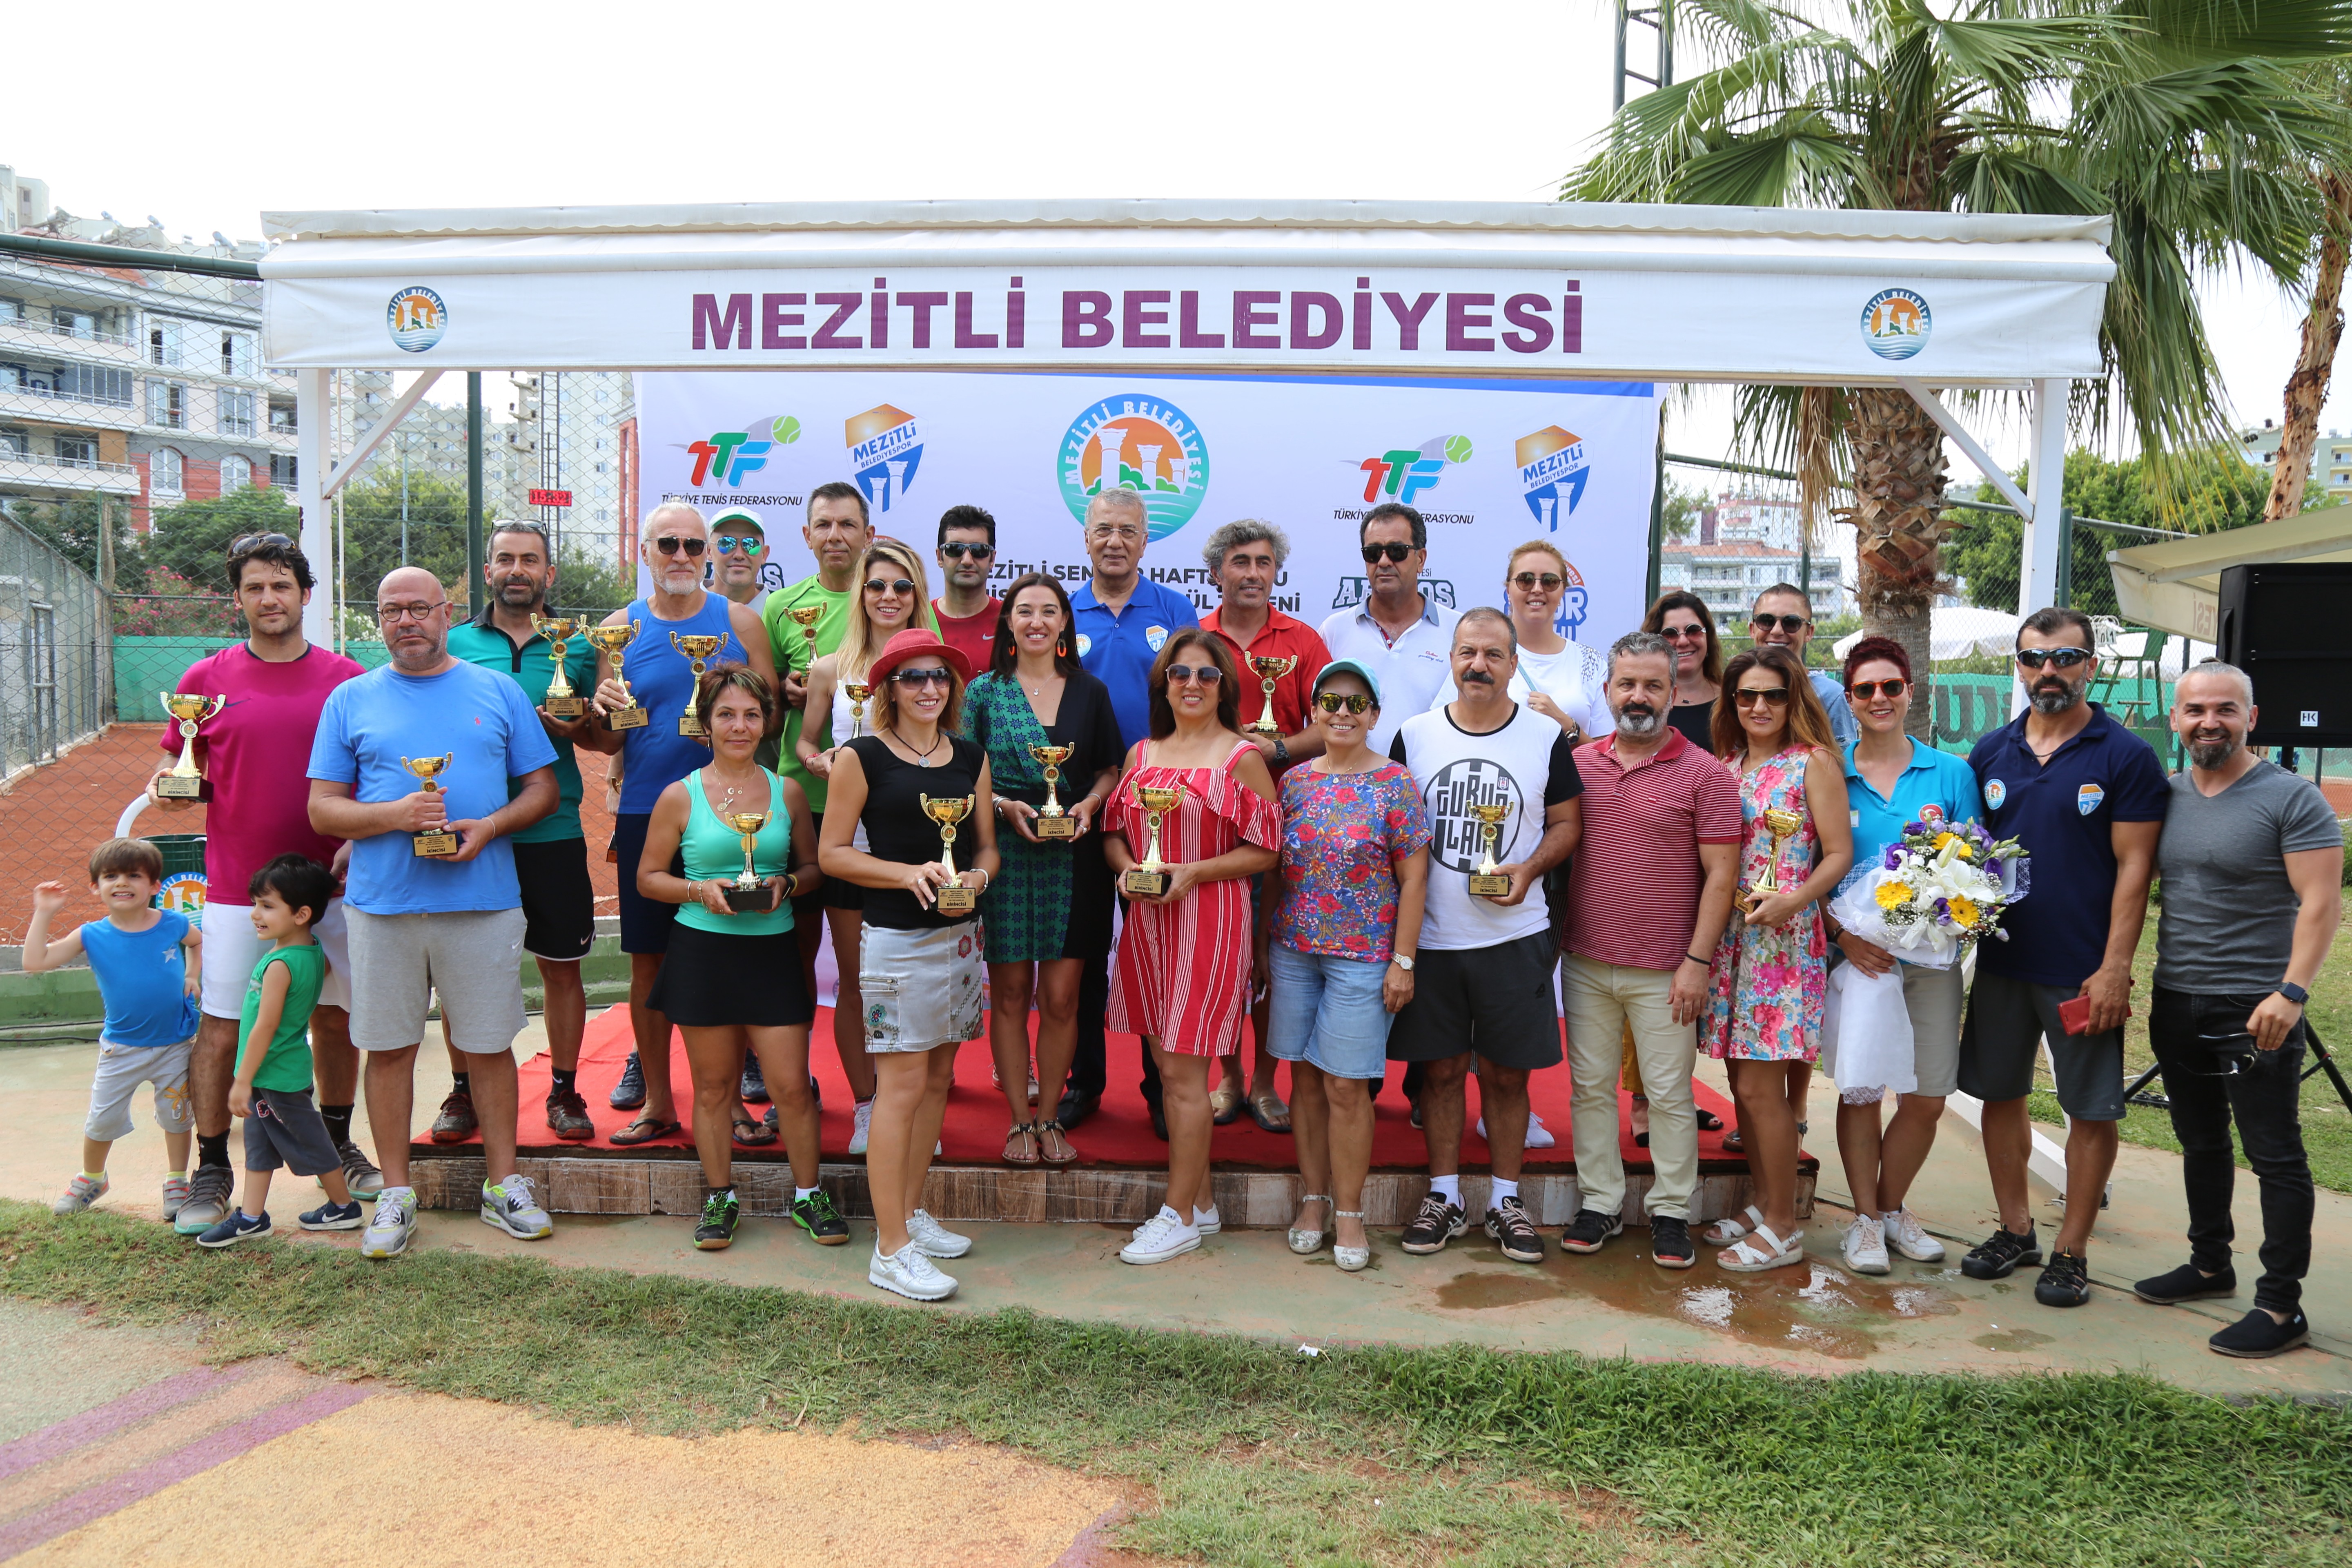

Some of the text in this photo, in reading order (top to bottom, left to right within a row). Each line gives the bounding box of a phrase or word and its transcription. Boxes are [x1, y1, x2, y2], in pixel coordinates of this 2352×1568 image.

[390, 289, 445, 327] MEZİTLİ BELEDİYESİ
[692, 276, 1583, 354] MEZİTLİ BELEDİYESİ
[1864, 291, 1930, 334] MEZİTLİ BELEDİYESİ
[687, 432, 773, 488] TTF
[1065, 401, 1204, 490] MEZİTLİ BELEDİYESİ
[1360, 450, 1446, 505] TTF
[702, 493, 727, 505] TENİS
[729, 495, 803, 506] FEDERASYONU
[1334, 508, 1474, 524] TÜRKİY ERASYONU
[1150, 568, 1211, 584] HAFT
[2303, 713, 2316, 722] HK
